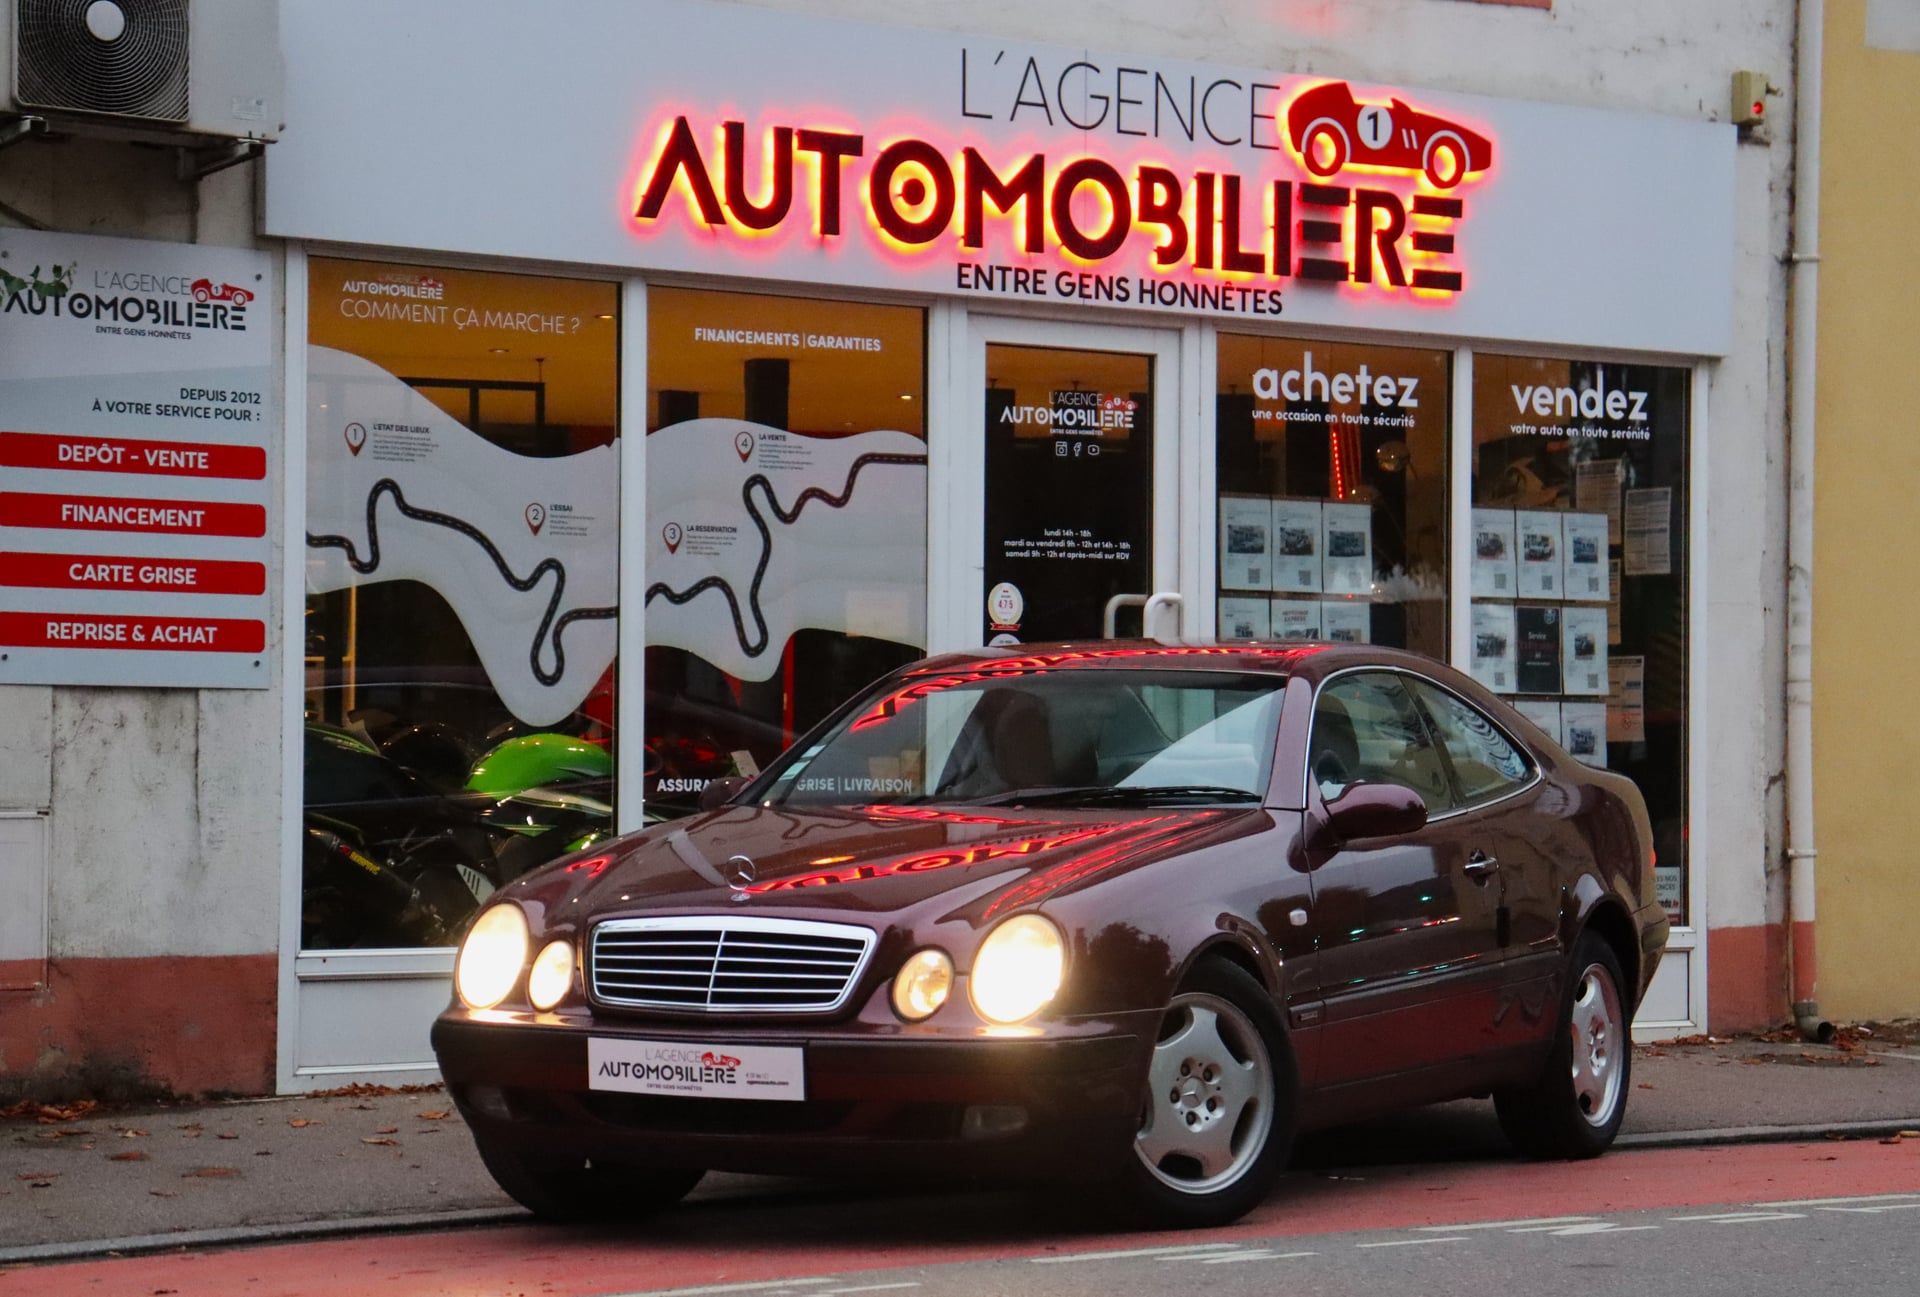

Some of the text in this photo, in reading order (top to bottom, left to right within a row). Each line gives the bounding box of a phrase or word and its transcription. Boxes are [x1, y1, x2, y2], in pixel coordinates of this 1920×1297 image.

[961, 47, 1281, 151] L'AGENCE
[1367, 111, 1380, 142] 1
[94, 270, 191, 296] L'AGENCE
[956, 262, 1283, 315] ENTRE GENS HONNÊTES
[340, 298, 581, 334] COMMENT ÇA MARCHE ?
[95, 325, 192, 341] ENTRE GENS HONNÊTES
[694, 327, 881, 351] FINANCEMENTS GARANTIES
[1253, 351, 1419, 407] achetez
[179, 387, 261, 404] DEPUIS 2012
[1048, 391, 1103, 407] L'AGENCE
[1511, 366, 1648, 421] vendez
[92, 398, 102, 412] À
[105, 400, 152, 415] VOTRE
[155, 404, 211, 419] SERVICE
[214, 407, 252, 421] POUR
[1251, 408, 1416, 428] une occasion en toute sécurité
[395, 424, 409, 433] DES
[410, 425, 430, 434] LIEUX
[759, 433, 787, 442] LA VENTE
[1510, 424, 1537, 435] votre
[1540, 426, 1563, 436] auto
[1566, 427, 1579, 437] en
[1581, 427, 1608, 438] toute
[741, 438, 749, 448] 4
[58, 443, 126, 464] DEPÔT
[144, 449, 209, 469] VENTE
[61, 503, 205, 527] FINANCEMENT
[532, 508, 539, 520] 2
[669, 527, 676, 539] 3
[1044, 528, 1061, 537] lundi
[1062, 529, 1074, 537] 14h
[1079, 529, 1092, 538] 18h
[1004, 538, 1025, 547] mardi
[1036, 539, 1065, 548] vendredi
[1066, 540, 1075, 548] 9h
[1081, 540, 1092, 549] 12h
[1101, 541, 1113, 549] 14h
[1119, 541, 1130, 550] 18h
[1005, 550, 1030, 558] samedi
[1031, 550, 1040, 558] 9h
[1046, 550, 1057, 558] 12h
[1067, 551, 1103, 561] après-midi
[1115, 552, 1130, 560] RDV
[69, 563, 197, 585] CARTE GRISE
[46, 621, 218, 644] REPRISE & ACHAT
[844, 777, 913, 794] LIVRAISON
[644, 1047, 700, 1064] L'AGENCE
